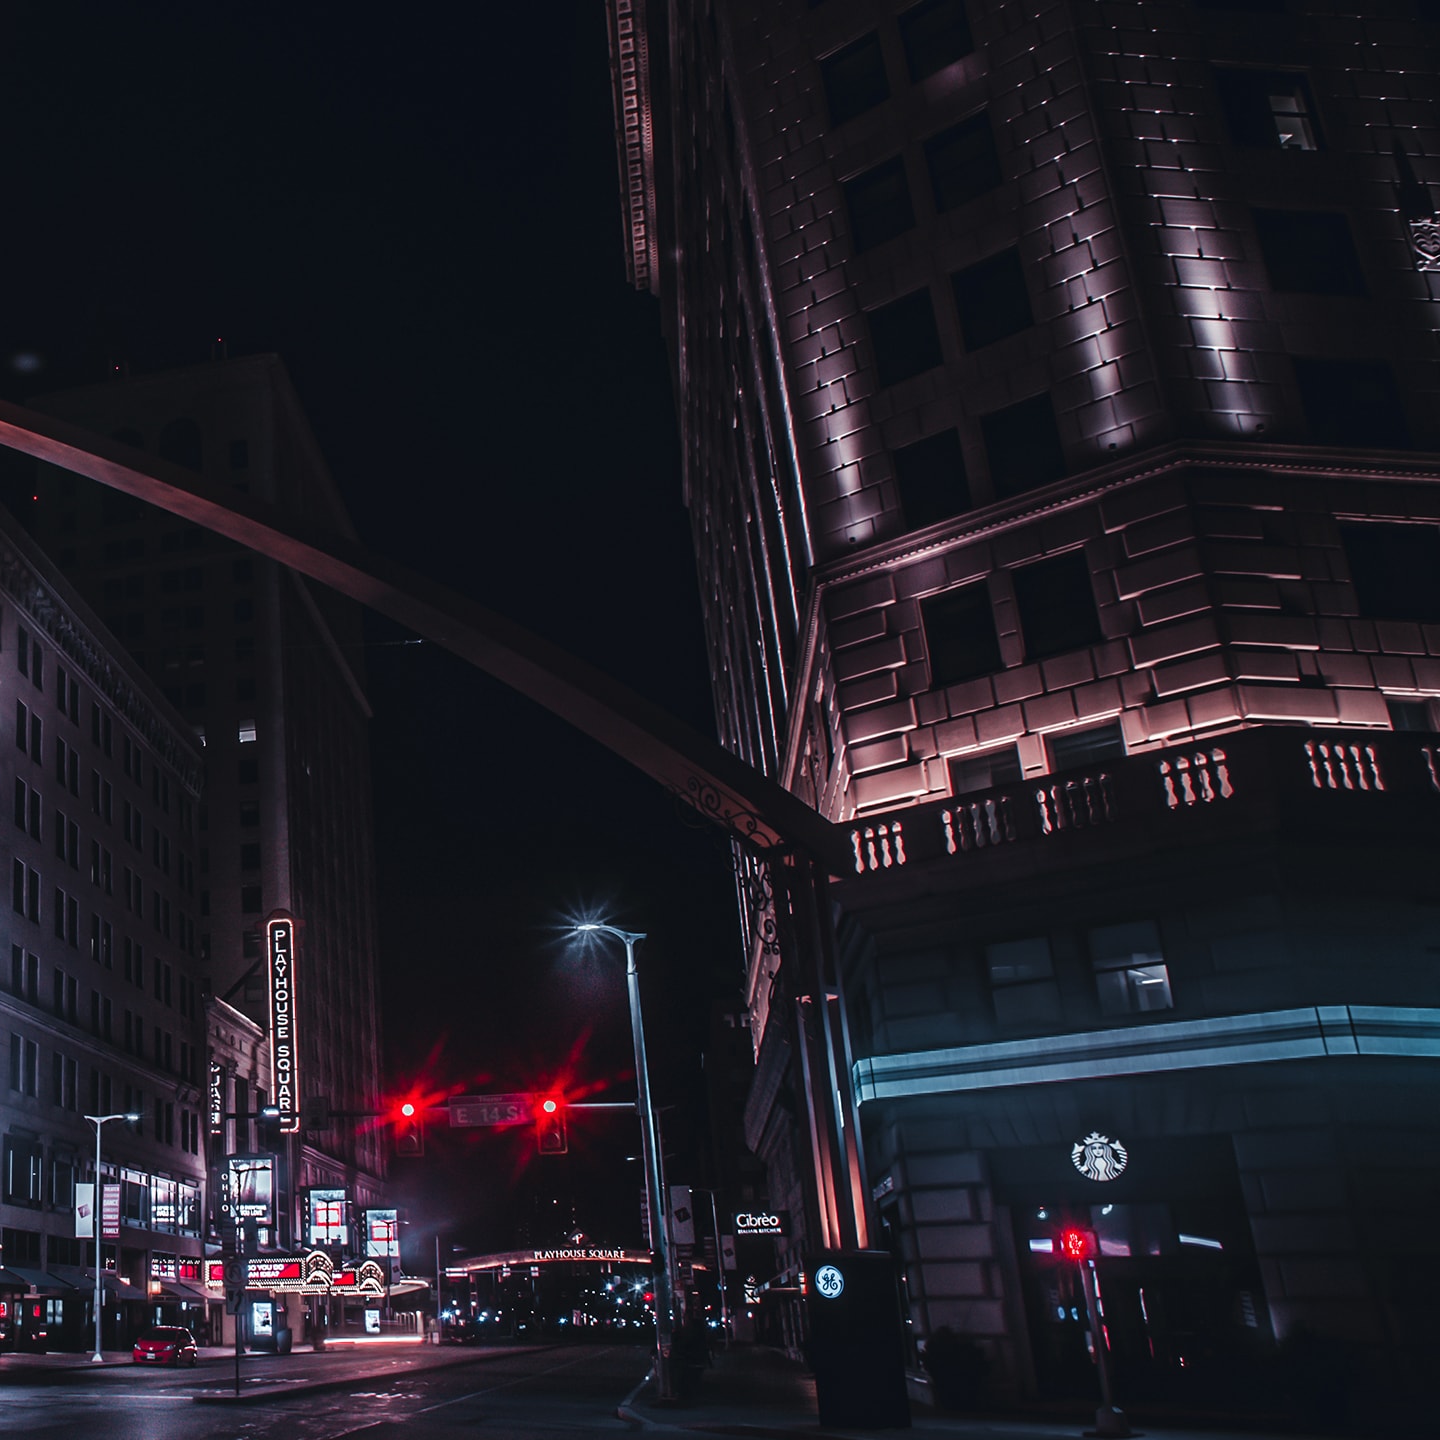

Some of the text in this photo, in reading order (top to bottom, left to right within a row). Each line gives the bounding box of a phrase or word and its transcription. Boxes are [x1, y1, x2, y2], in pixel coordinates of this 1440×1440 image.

[274, 929, 289, 1038] PLAYHOUSE
[480, 1106, 500, 1122] 14
[221, 1173, 229, 1212] OHIO
[736, 1212, 780, 1228] Cibrèo
[534, 1249, 625, 1260] PLAYHOUSE SQUARE
